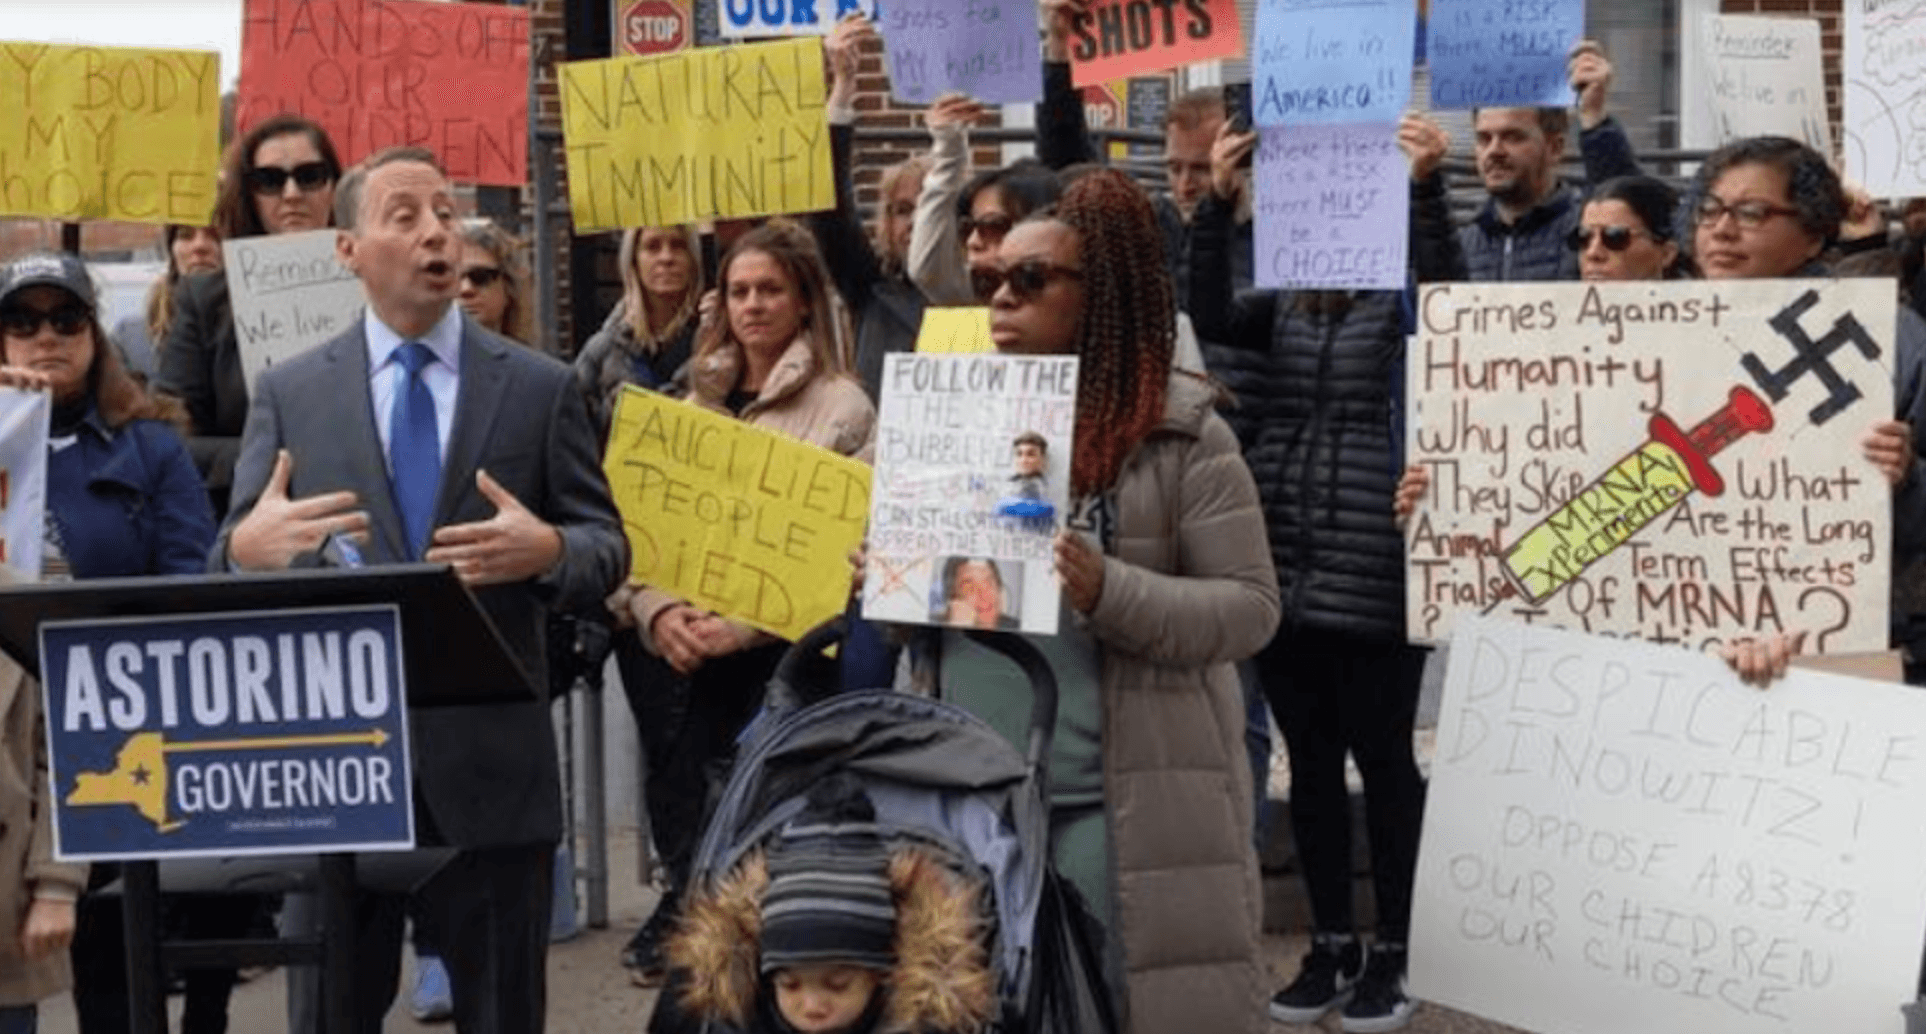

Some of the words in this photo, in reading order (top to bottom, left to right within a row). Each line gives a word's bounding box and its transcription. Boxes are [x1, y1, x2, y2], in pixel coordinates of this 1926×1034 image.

[244, 0, 443, 60] HANDS
[455, 10, 531, 60] OFF
[631, 17, 679, 43] STOP
[1071, 0, 1212, 63] SHOTS
[62, 47, 211, 116] BODY
[307, 57, 430, 112] OUR
[562, 45, 826, 136] NATURAL
[24, 113, 118, 166] MY
[1318, 187, 1382, 216] MUST
[236, 310, 285, 344] We
[292, 304, 335, 336] live
[1423, 287, 1557, 334] Crimes
[1576, 286, 1731, 344] Against
[892, 358, 1010, 394] FOLLOW
[1015, 360, 1074, 395] THE
[1424, 337, 1664, 413] Humanity
[1416, 394, 1508, 479] Why
[1526, 390, 1588, 453] did
[1419, 458, 1511, 528] They
[1736, 457, 1862, 502] What
[624, 458, 817, 563] PEOPLE
[1411, 513, 1501, 558] Animal
[1663, 500, 1730, 537] Are
[1736, 502, 1793, 537] the
[1802, 507, 1875, 564] Long
[1624, 540, 1709, 582] Term
[1730, 547, 1857, 587] Effects
[1636, 581, 1783, 634] MRNA
[63, 628, 391, 733] ASTORINO
[1463, 636, 1918, 788] DESPICABLE
[175, 755, 395, 813] GOVERNOR
[1502, 804, 1678, 879] OPPOSE
[1694, 852, 1857, 933] A8378
[1448, 852, 1559, 921] OUR
[1580, 888, 1834, 991] CHIDREN
[1458, 906, 1556, 963] OUR
[1583, 936, 1794, 1023] CHOICE
